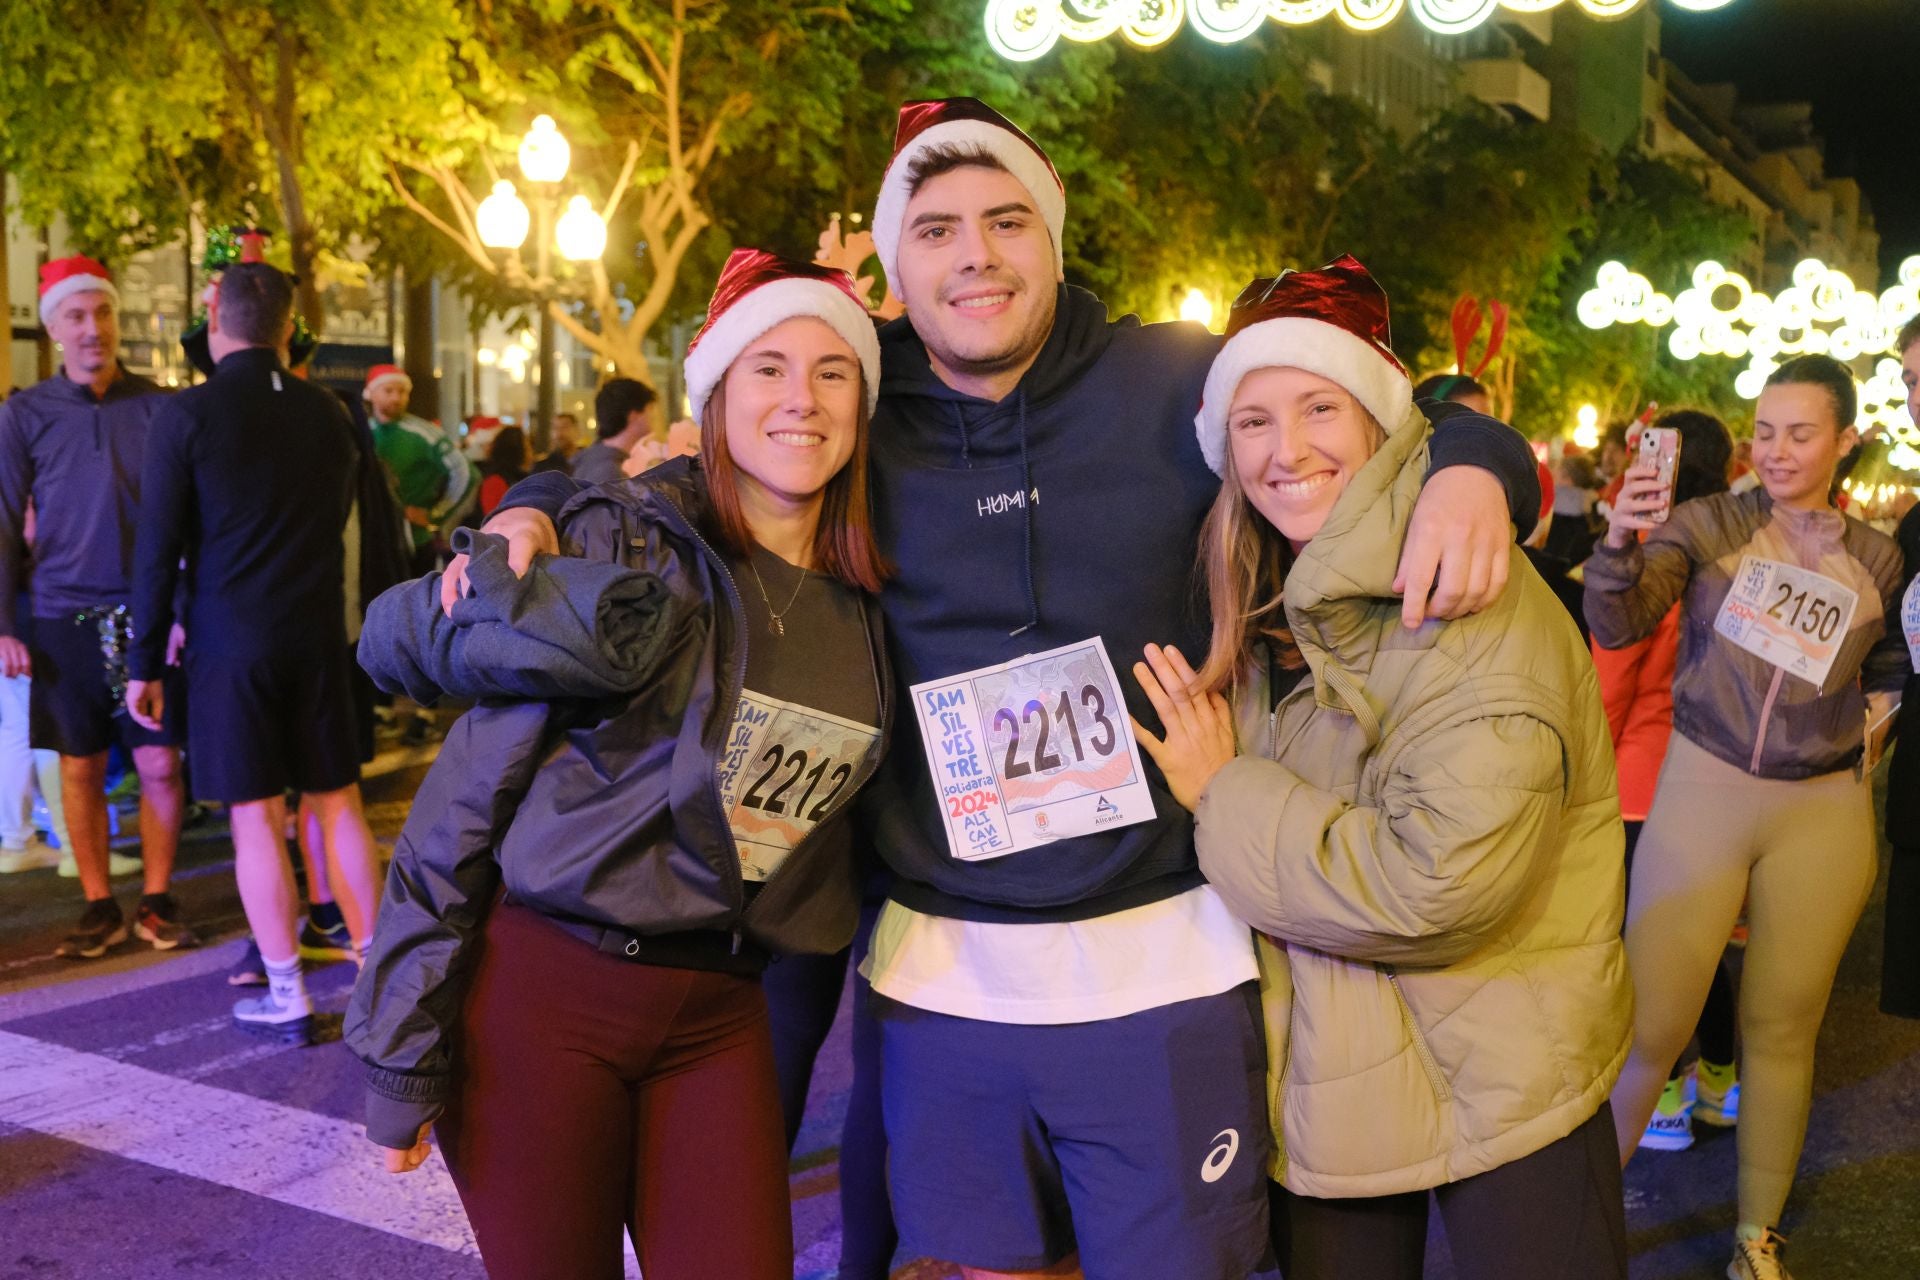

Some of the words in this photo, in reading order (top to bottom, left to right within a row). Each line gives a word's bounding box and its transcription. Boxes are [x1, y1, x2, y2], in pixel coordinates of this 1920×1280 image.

[1766, 583, 1841, 642] 2150
[735, 700, 770, 727] SAN
[926, 688, 965, 716] SAN
[941, 730, 975, 756] VES
[993, 684, 1115, 780] 2213
[946, 754, 983, 778] TRE
[741, 743, 852, 822] 2212
[948, 790, 998, 817] 2024
[965, 811, 991, 830] ALI
[1095, 813, 1124, 825] Alicante
[969, 824, 997, 843] CAN
[972, 835, 1002, 852] TE
[1651, 1118, 1685, 1129] HOKA
